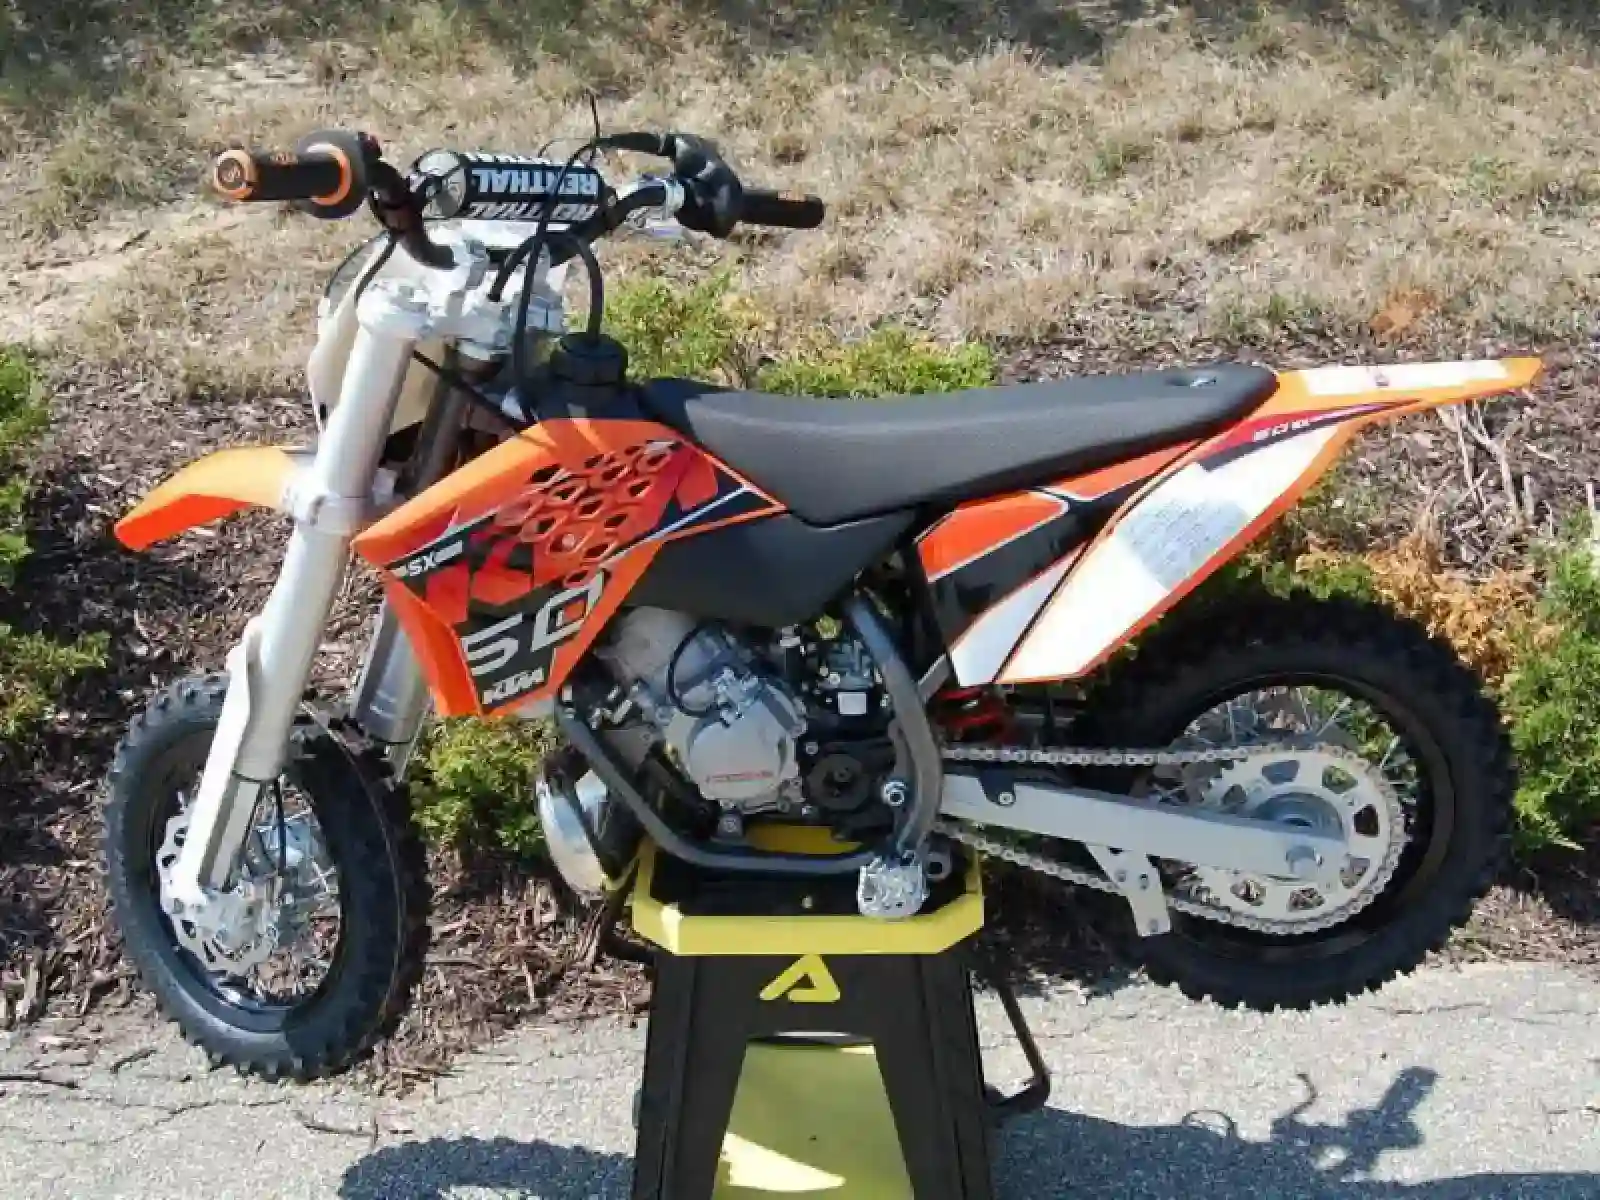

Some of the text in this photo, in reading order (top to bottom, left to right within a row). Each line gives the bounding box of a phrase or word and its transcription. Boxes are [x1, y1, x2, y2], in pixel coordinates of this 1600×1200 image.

[471, 168, 599, 197] RENTHAL
[460, 571, 604, 677] 50
[482, 666, 545, 704] KTM
